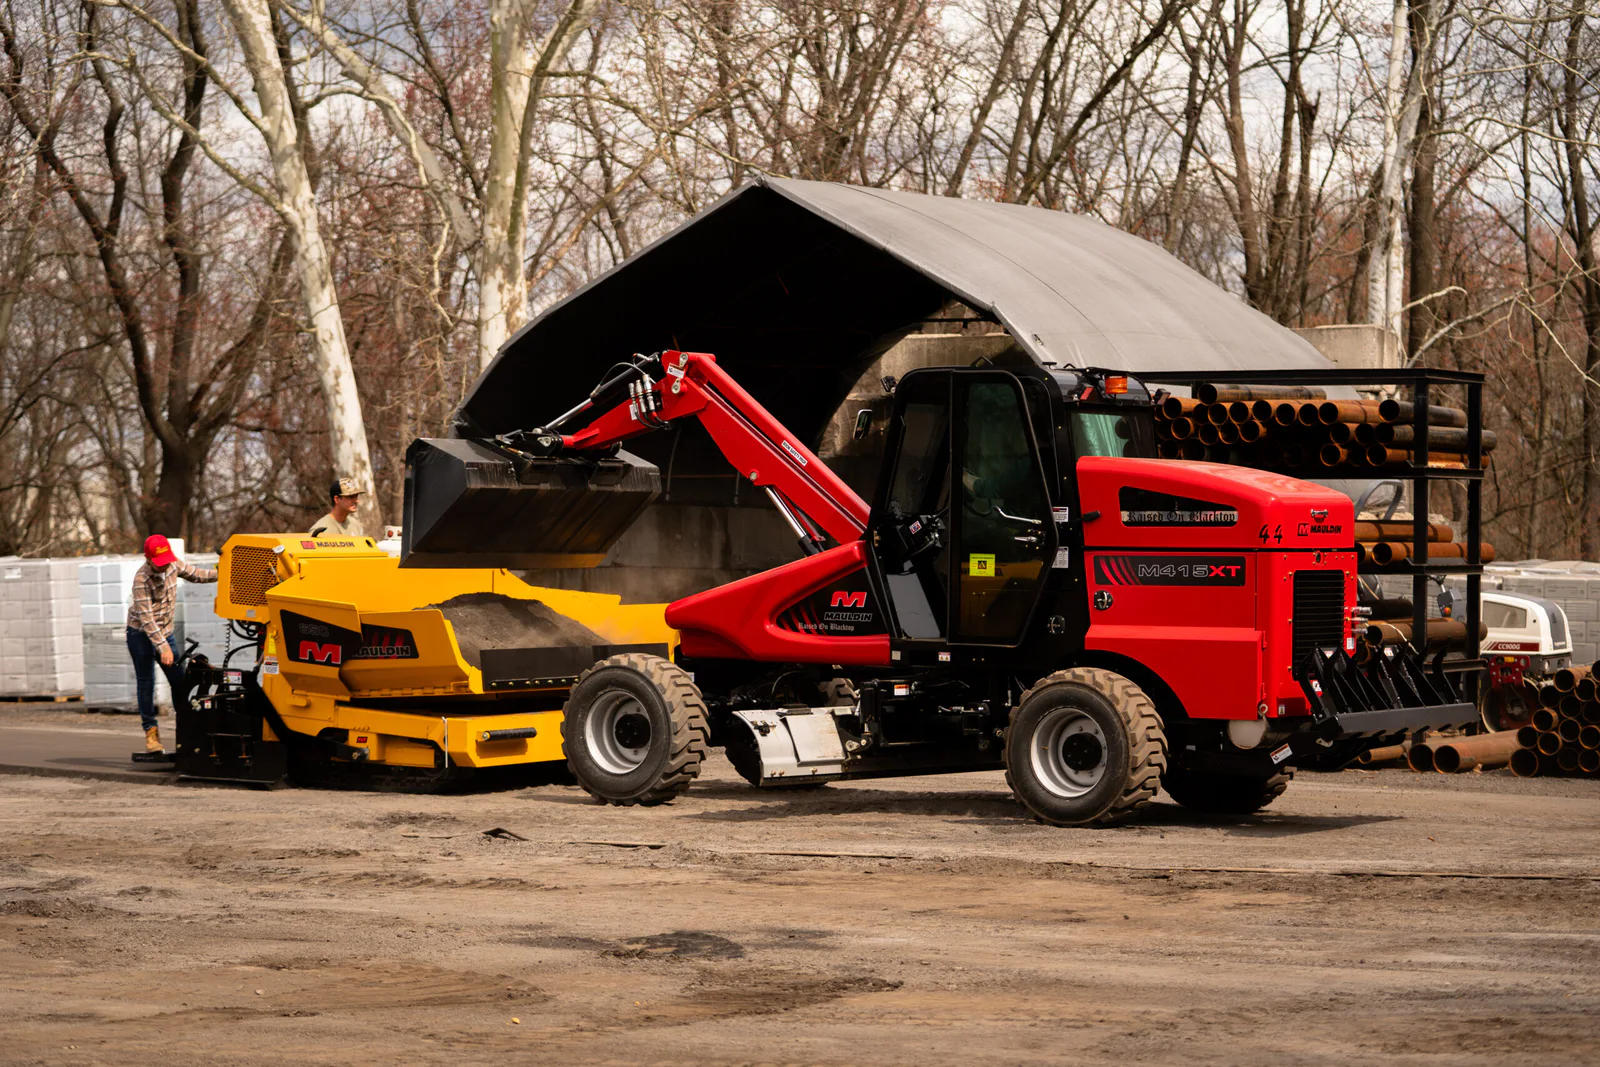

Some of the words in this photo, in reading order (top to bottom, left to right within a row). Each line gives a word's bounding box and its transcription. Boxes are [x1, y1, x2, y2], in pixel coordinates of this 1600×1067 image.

[1127, 509, 1164, 522] Raised
[1167, 510, 1184, 522] On
[1189, 510, 1236, 522] Blacktop
[1298, 523, 1309, 536] M
[1310, 525, 1342, 534] MAULDIN
[1138, 564, 1241, 578] M415XT
[830, 591, 867, 608] M
[824, 612, 873, 622] MAULDIN
[797, 621, 817, 630] Raised
[819, 622, 828, 630] On
[829, 622, 855, 632] Blacktop
[299, 640, 341, 665] M
